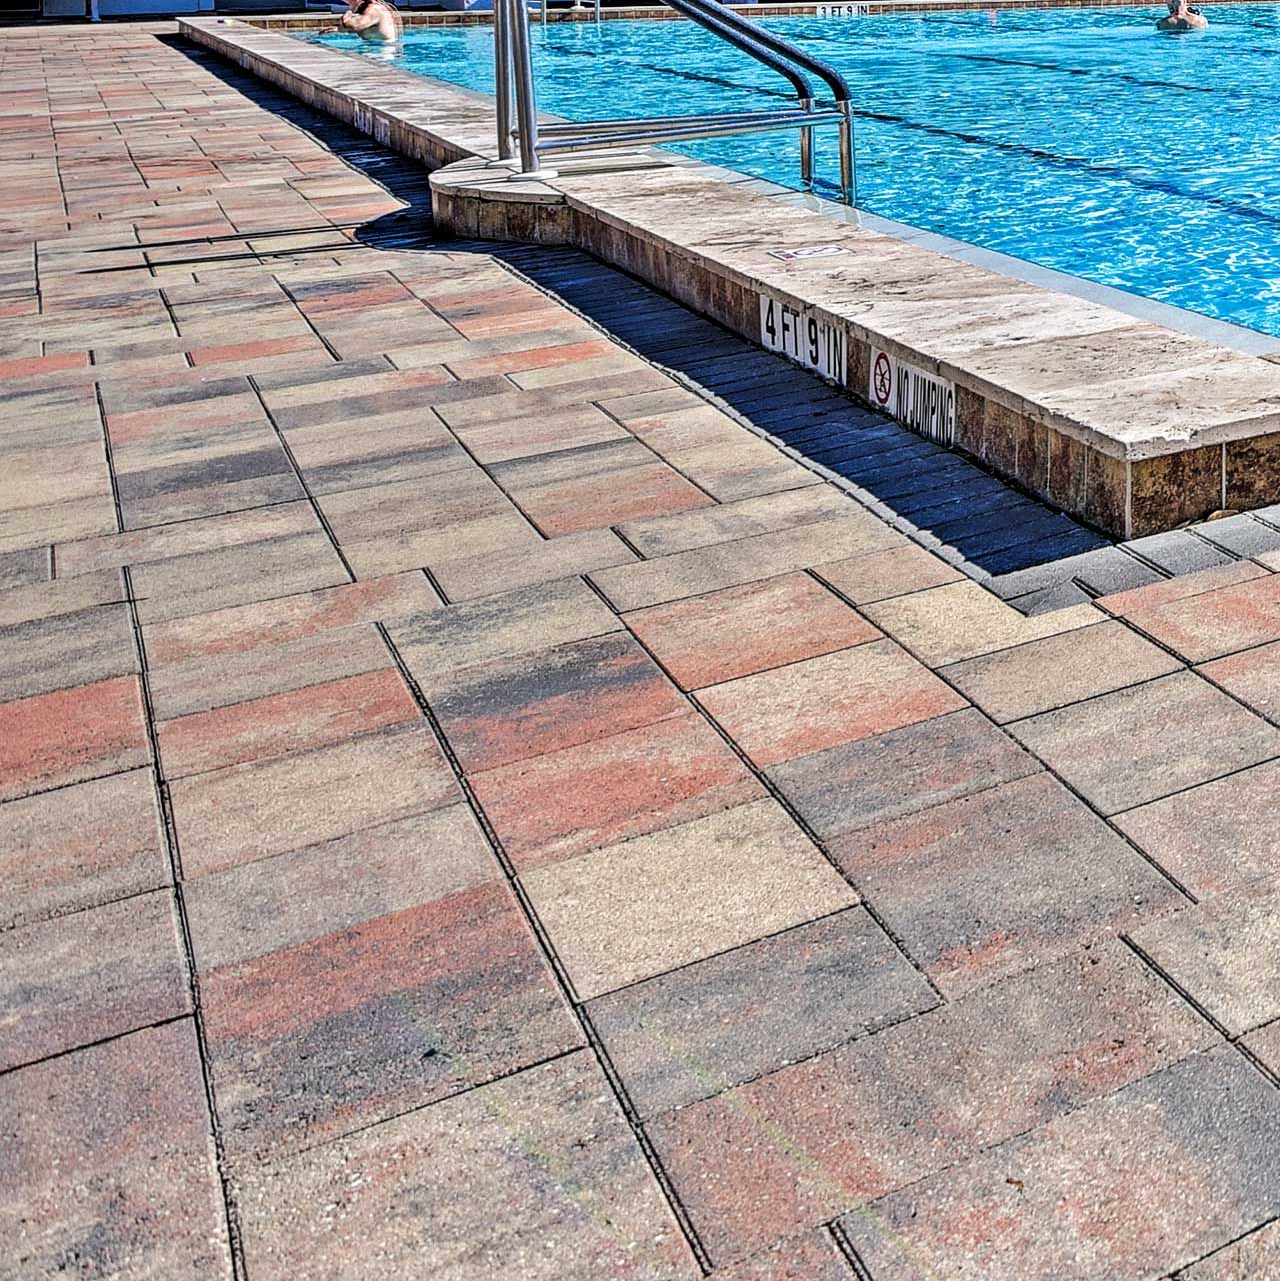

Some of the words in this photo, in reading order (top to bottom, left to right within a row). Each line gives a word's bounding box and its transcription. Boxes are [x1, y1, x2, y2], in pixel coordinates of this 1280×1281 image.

[831, 5, 842, 17] FT
[846, 5, 853, 16] 9
[857, 5, 868, 16] IN
[765, 298, 777, 347] 4
[781, 305, 801, 357] FT
[807, 316, 820, 366] 9
[825, 325, 844, 382] IN
[896, 365, 909, 423] NO
[910, 372, 955, 448] JUMPING
